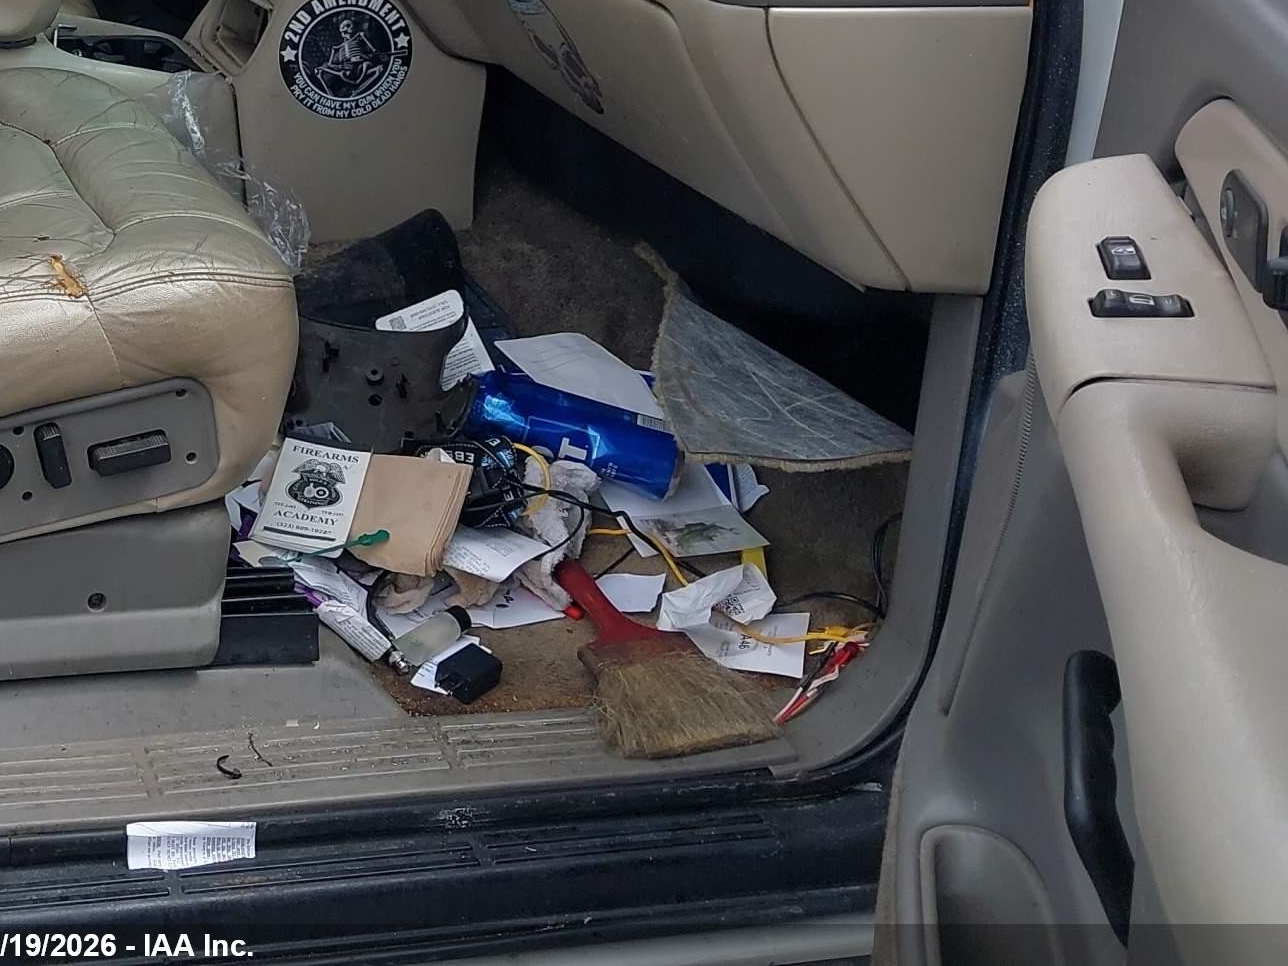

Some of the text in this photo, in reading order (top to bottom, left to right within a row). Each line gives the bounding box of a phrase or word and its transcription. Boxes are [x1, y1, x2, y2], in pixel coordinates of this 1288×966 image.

[284, 10, 312, 43] 2ND
[290, 65, 409, 118] PRY IT FROM MY COLD DEAD HANDS
[294, 58, 403, 110] YOU CAN HAVE MY GUN WHEN YOU
[292, 445, 360, 464] FIREARMS
[273, 510, 338, 527] ACADEMY
